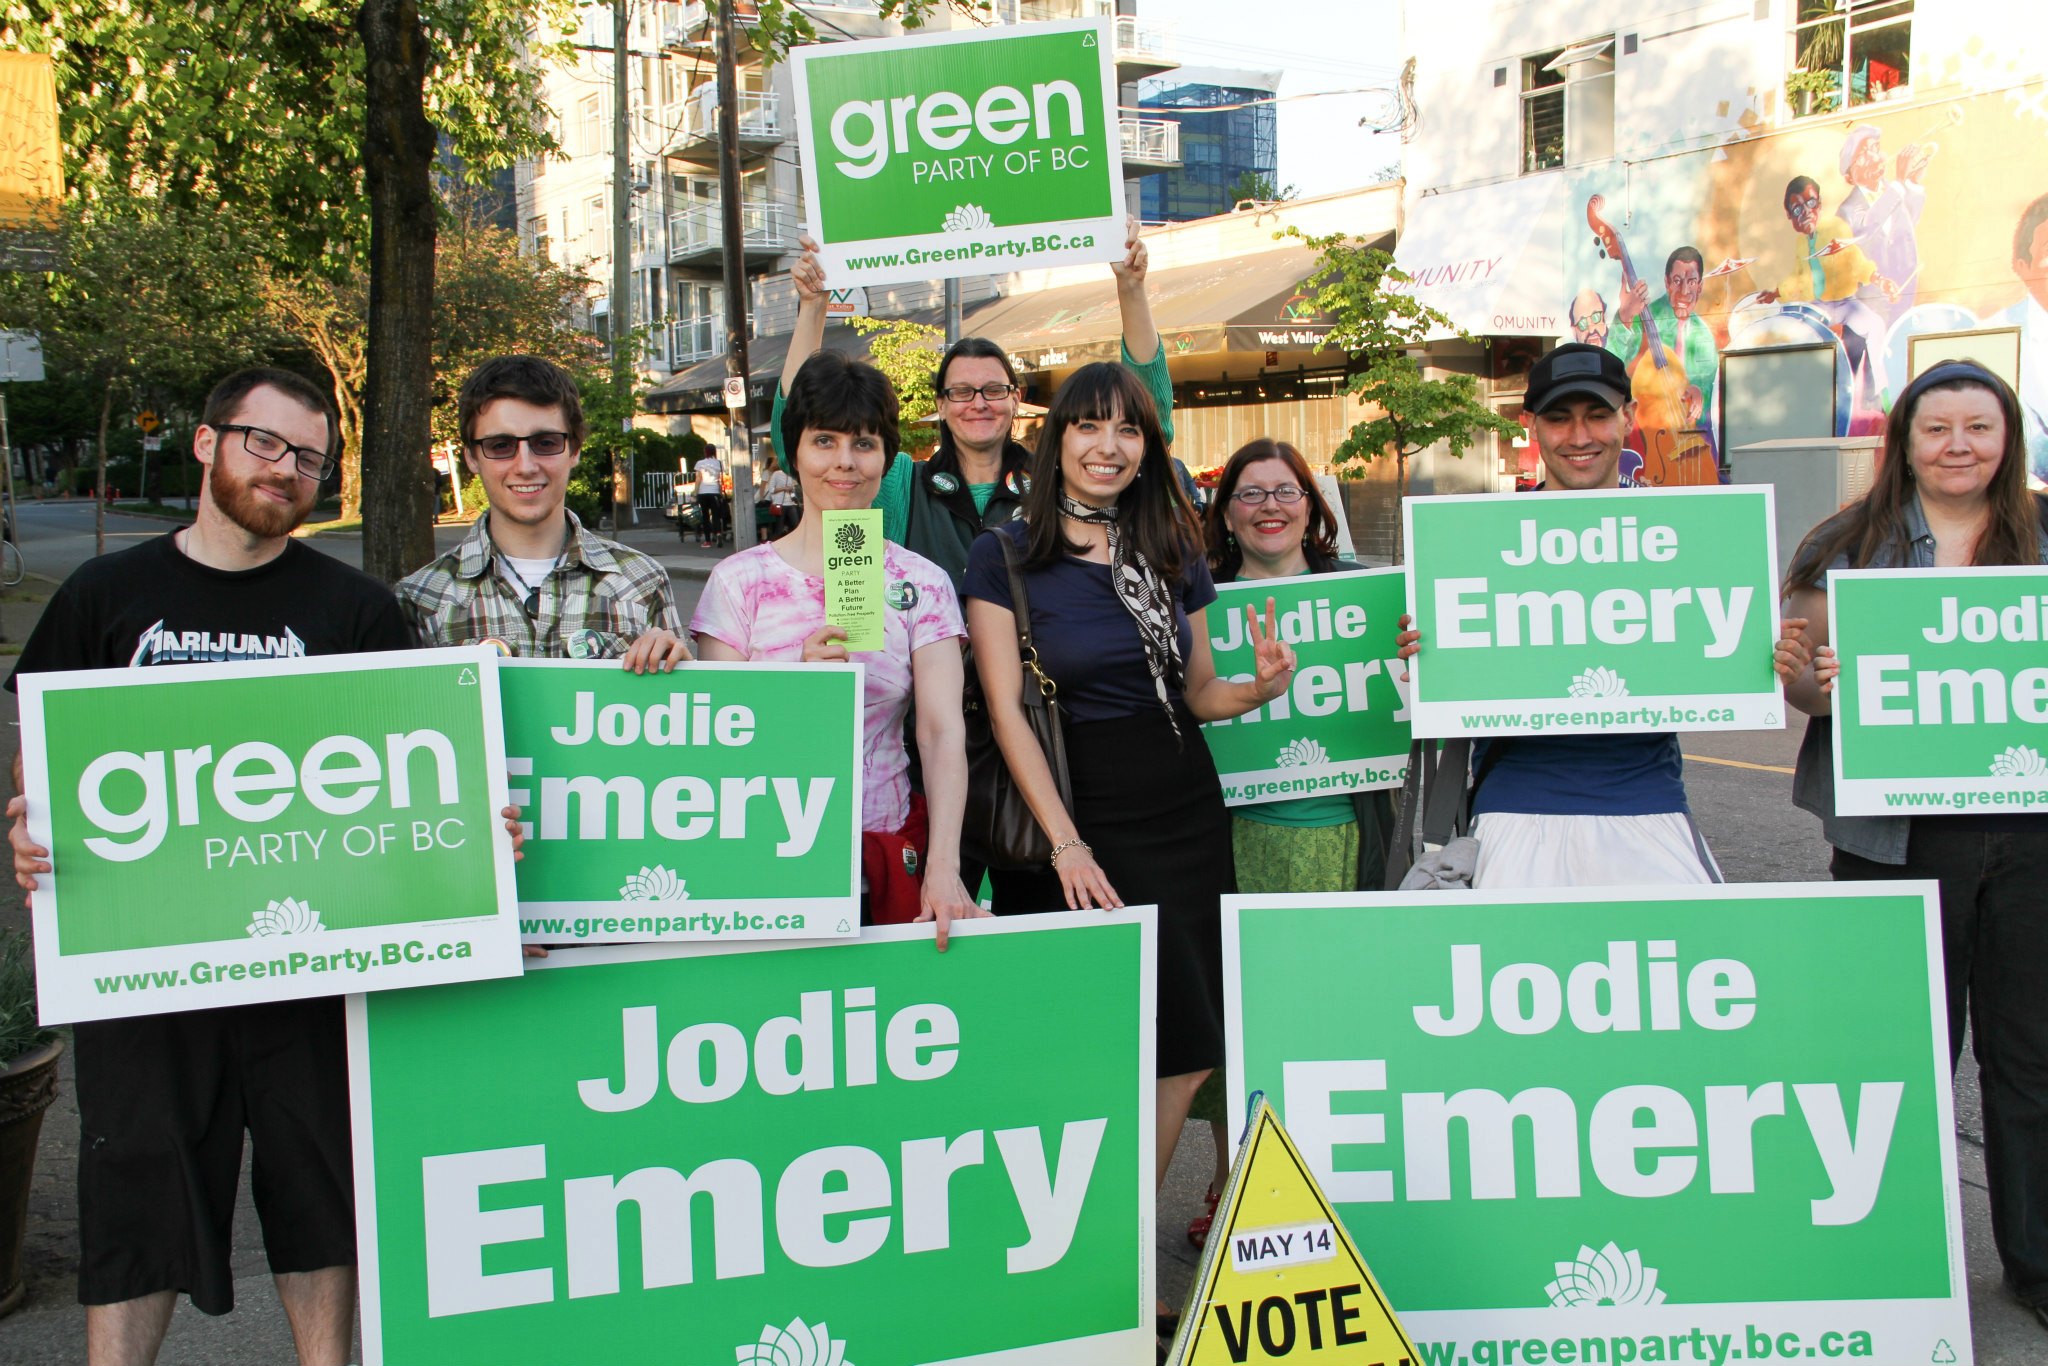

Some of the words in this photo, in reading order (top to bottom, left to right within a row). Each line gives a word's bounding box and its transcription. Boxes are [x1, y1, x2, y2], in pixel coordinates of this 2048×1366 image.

[830, 79, 1085, 180] green
[913, 157, 996, 184] PARTY
[1004, 152, 1043, 175] OF
[1052, 145, 1090, 170] BC
[846, 235, 1094, 271] www.GreenParty.BC.ca
[1258, 331, 1289, 345] West
[1494, 315, 1556, 330] QMUNITY
[1040, 347, 1068, 367] arket
[828, 555, 872, 570] green
[1500, 517, 1678, 567] Jodie
[129, 619, 306, 667] MARIJUANA
[1434, 578, 1754, 658] Emery
[1857, 654, 2048, 726] Eme
[551, 691, 756, 747] Jodie
[1461, 705, 1735, 731] www.greenparty.bc.ca
[77, 729, 460, 863] green
[205, 829, 328, 870] PARTY
[343, 823, 396, 858] OF
[412, 818, 467, 852] BC
[95, 937, 472, 995] www.GreenParty.BC.ca
[1413, 939, 1757, 1037] Jodie
[577, 986, 960, 1113] Jodie
[1283, 1060, 1904, 1226] Emery
[422, 1117, 1108, 1317] Emery
[1236, 1233, 1293, 1262] MAY
[1303, 1228, 1331, 1252] 14
[1214, 1283, 1368, 1364] VOTE
